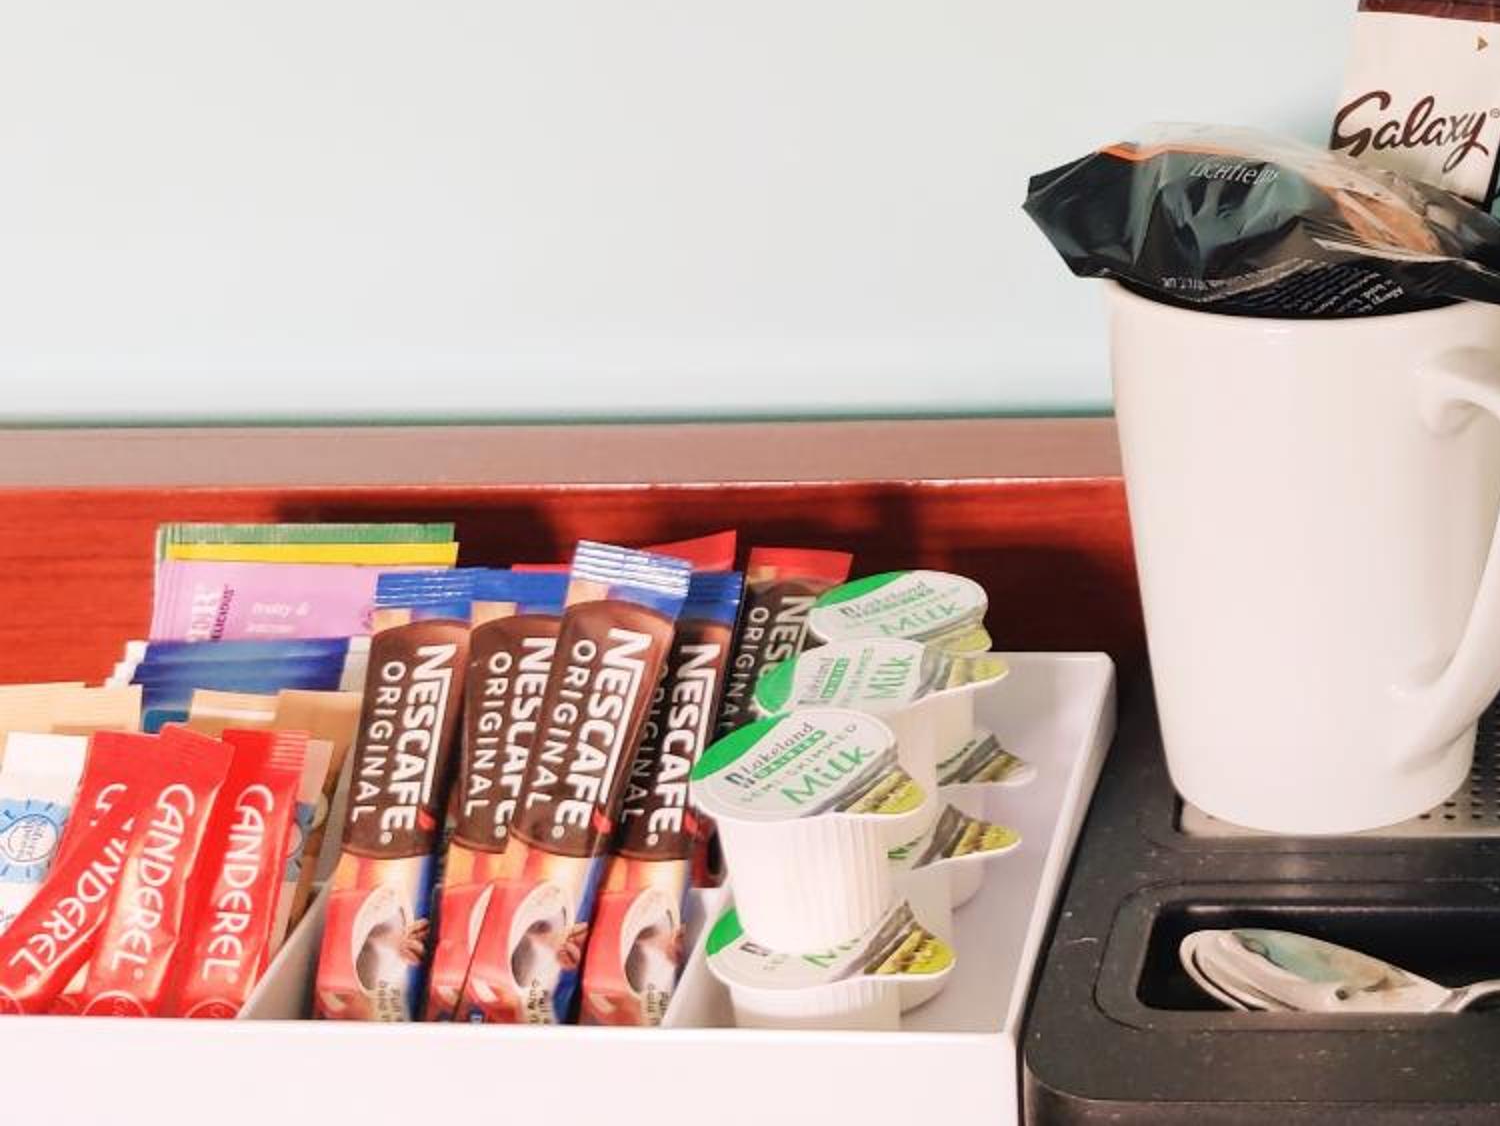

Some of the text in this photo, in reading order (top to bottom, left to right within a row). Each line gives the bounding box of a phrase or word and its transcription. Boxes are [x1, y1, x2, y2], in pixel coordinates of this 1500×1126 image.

[1330, 90, 1489, 174] Galaxy
[351, 660, 407, 822] ORIGINAL
[464, 651, 513, 817] ORIGINAL
[525, 639, 598, 811] ORIGINAL
[780, 744, 876, 805] Milk
[111, 782, 196, 971] CANDEREL
[201, 783, 275, 981] CANDEREL
